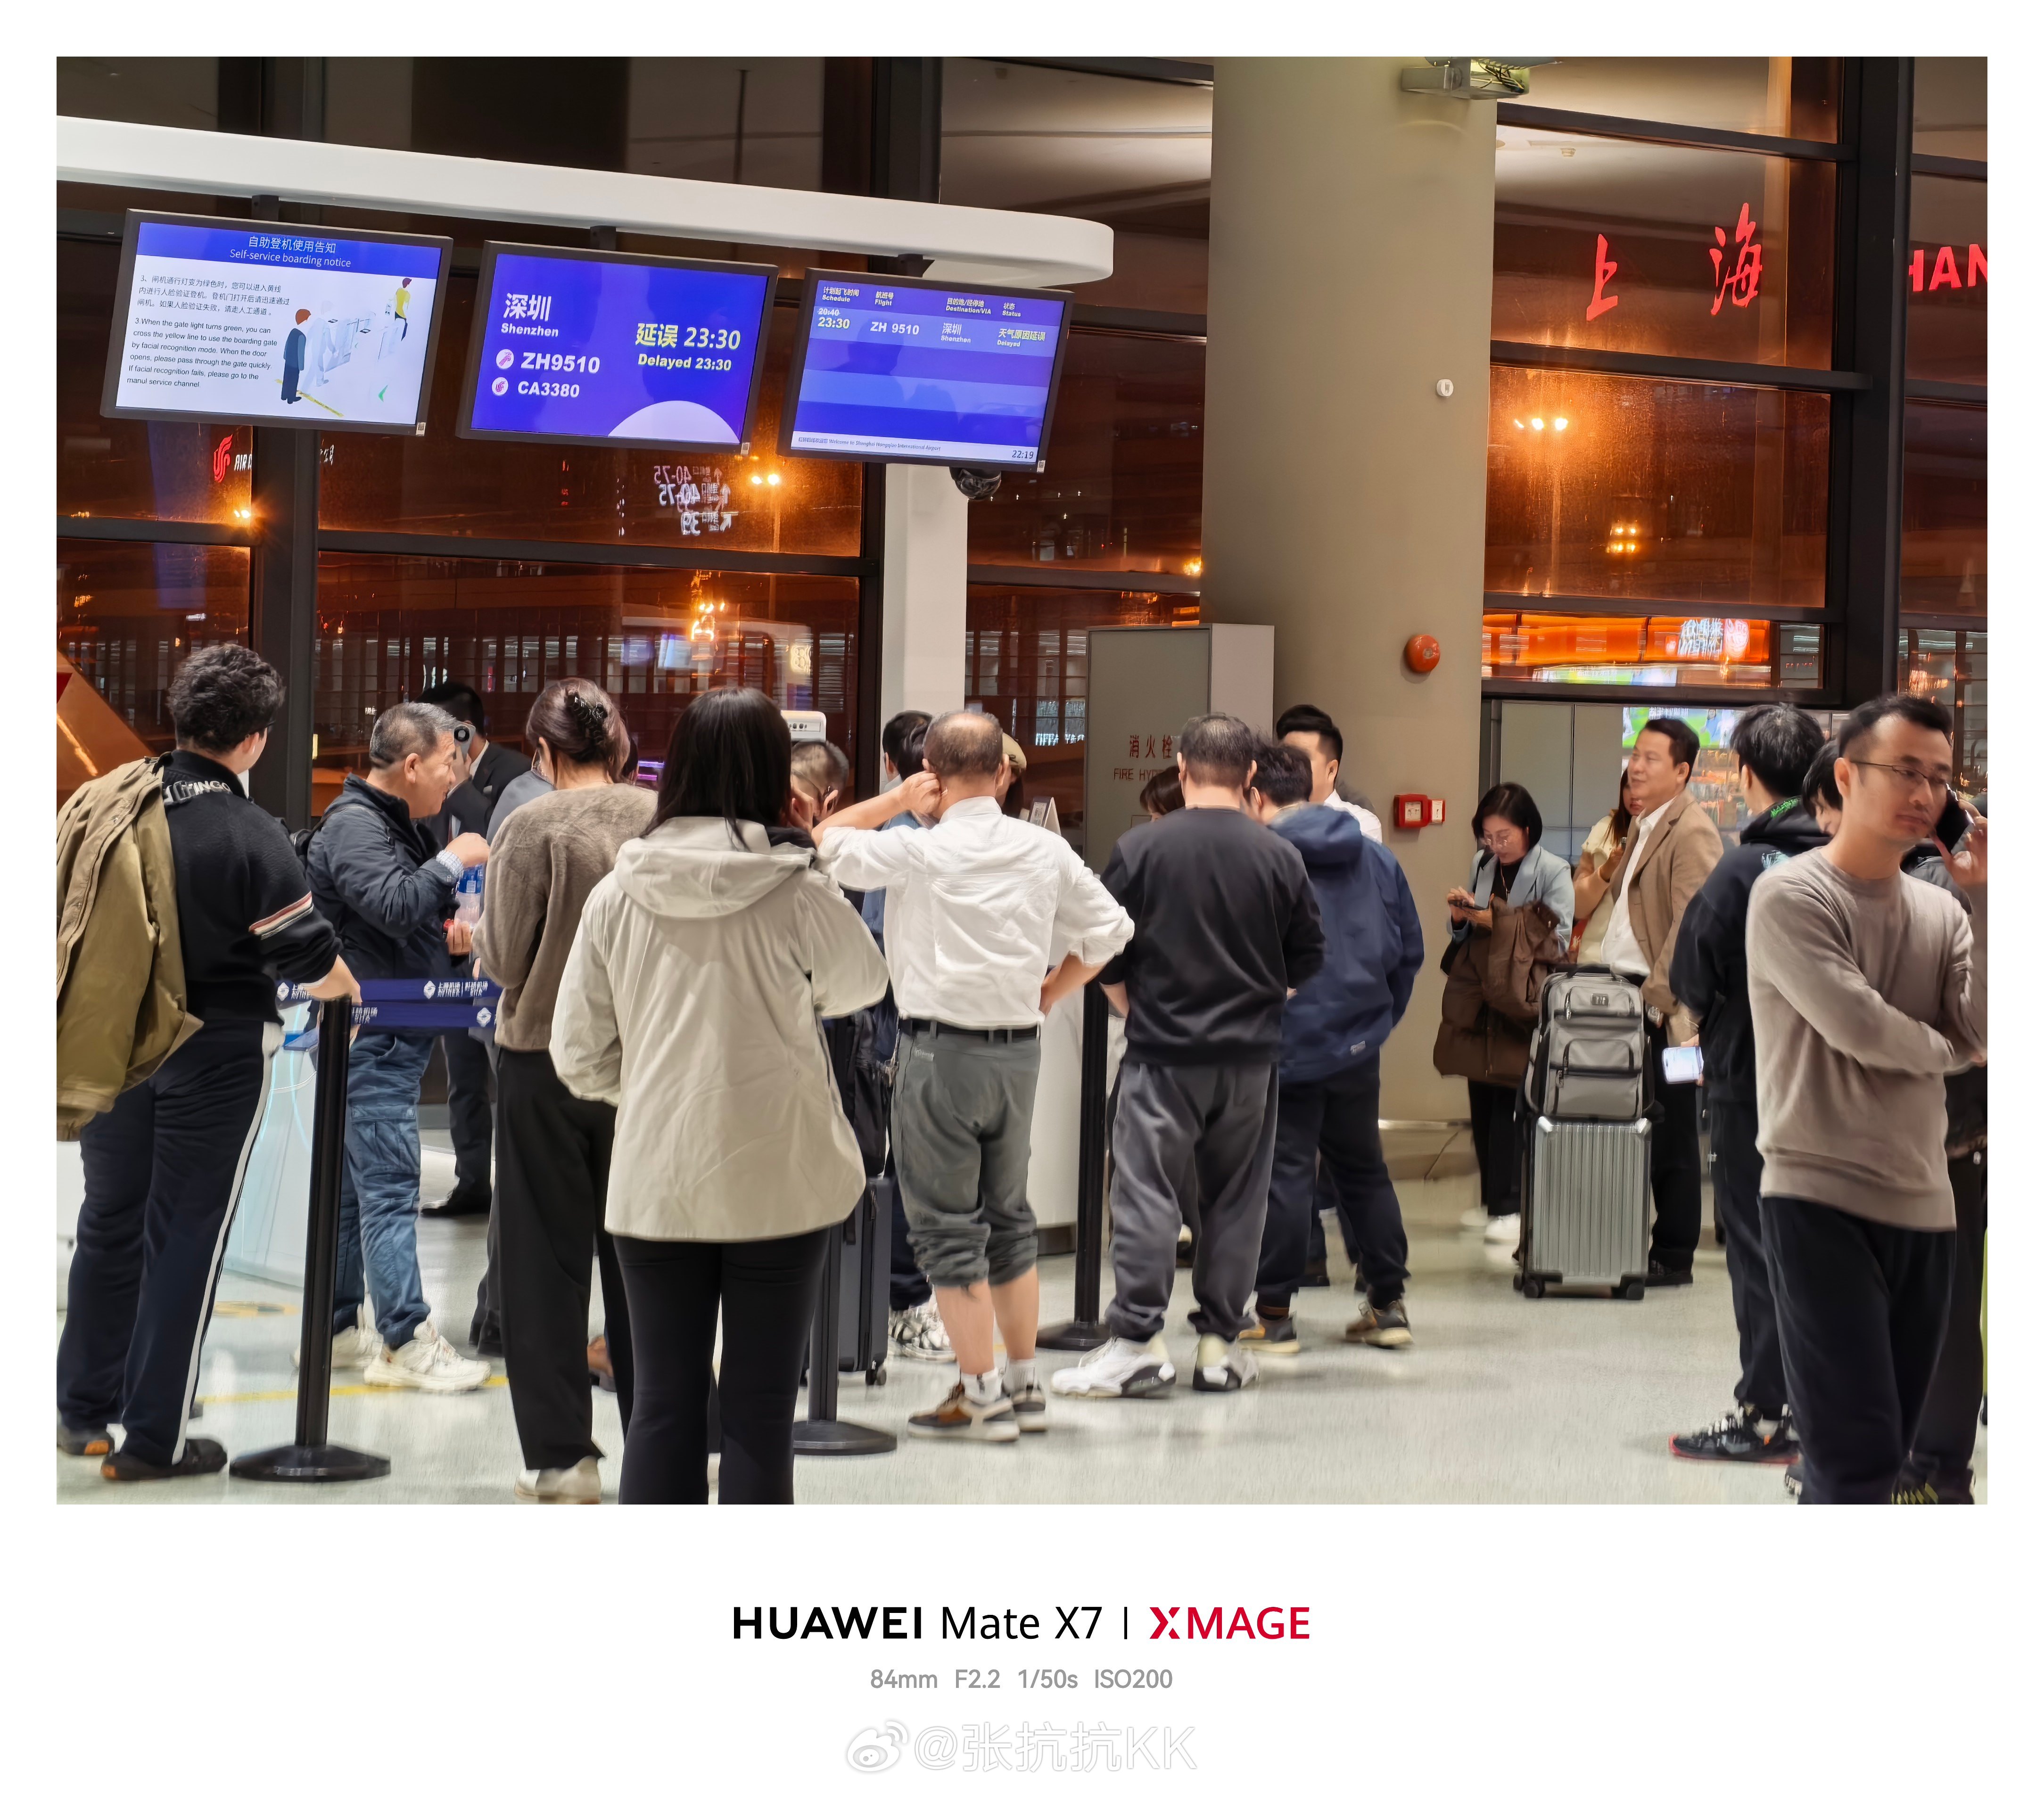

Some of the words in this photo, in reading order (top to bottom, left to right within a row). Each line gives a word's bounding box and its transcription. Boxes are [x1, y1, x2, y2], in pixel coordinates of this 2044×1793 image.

[249, 235, 336, 254] 自助登机使用告知
[230, 249, 280, 262] Self-service
[283, 253, 321, 266] boarding
[324, 257, 351, 267] notice
[1586, 202, 1763, 321] 上海
[876, 291, 894, 299] 航班号
[503, 293, 552, 321] 深圳
[946, 306, 991, 314] Destination/VIA
[501, 323, 559, 337] Shenzhen
[818, 317, 850, 329] 23:30
[870, 321, 887, 332] ZH
[891, 323, 920, 335] 9510
[942, 322, 962, 335] 深圳
[165, 332, 185, 340] yellow
[234, 337, 262, 345] boarding
[635, 323, 679, 348] 延误
[684, 327, 741, 350] 23:30
[941, 335, 971, 343] Shenzhen
[161, 344, 196, 352] recognition
[154, 355, 176, 363] please
[520, 352, 600, 373] ZH9510
[638, 354, 692, 370] Delayed
[695, 357, 732, 371] 23:30
[154, 367, 189, 375] recognition
[518, 381, 580, 397] CA3380
[1012, 449, 1034, 460] 22:19
[234, 454, 247, 471] AIR
[1129, 734, 1172, 759] 消火栓
[1114, 768, 1134, 781] FIRE
